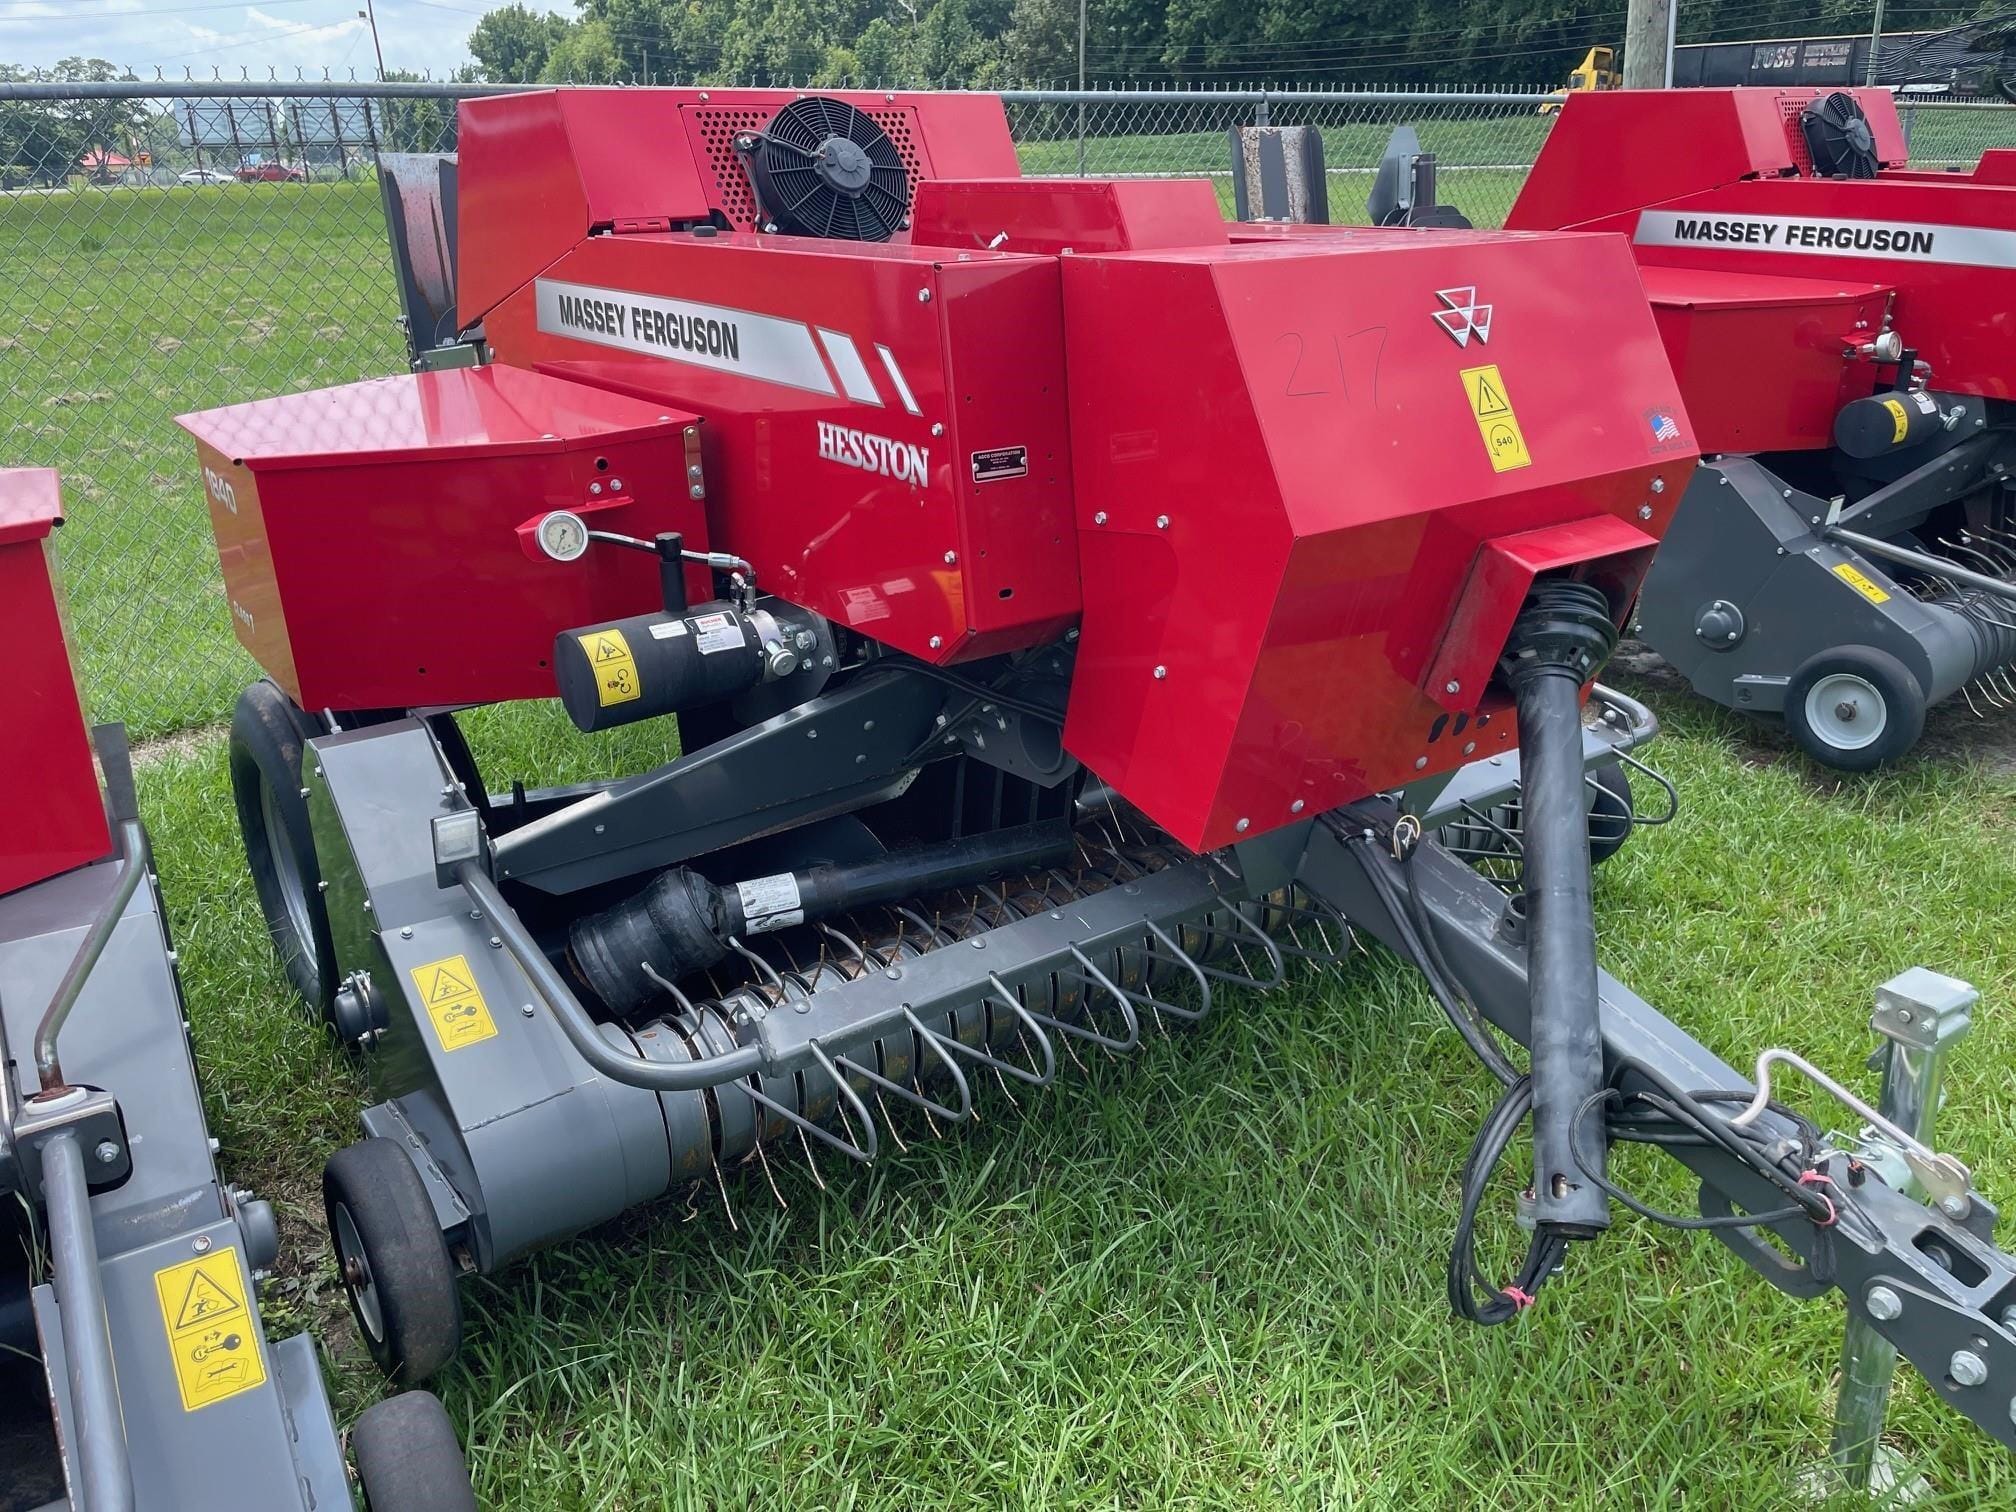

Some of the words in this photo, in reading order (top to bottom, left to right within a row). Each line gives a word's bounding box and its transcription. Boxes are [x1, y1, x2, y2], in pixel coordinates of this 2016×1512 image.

[1674, 219, 1778, 244] MASSEY
[1785, 225, 1934, 254] FERGUSON
[558, 294, 625, 338] MASSEY
[631, 306, 740, 361] FERGUSON
[817, 420, 929, 488] HESSTON
[1496, 436, 1513, 447] 540
